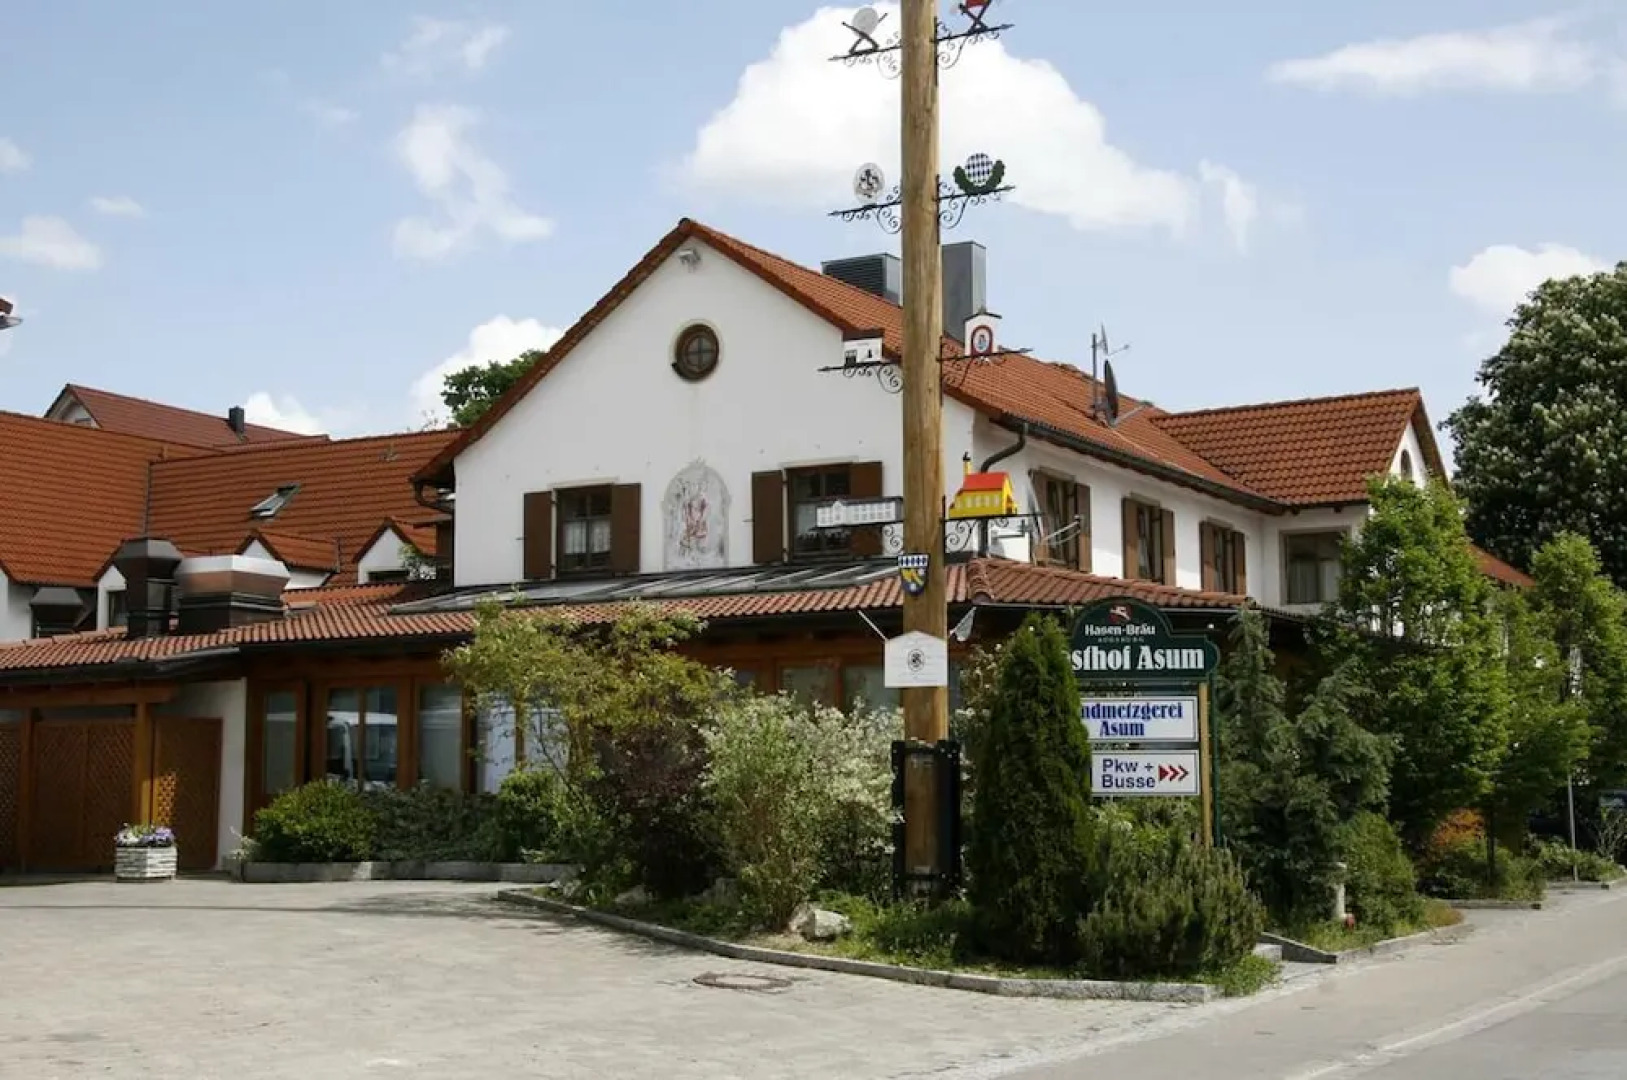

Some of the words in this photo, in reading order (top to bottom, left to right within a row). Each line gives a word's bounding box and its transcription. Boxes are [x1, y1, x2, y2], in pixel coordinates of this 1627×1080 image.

[1084, 623, 1155, 636] Hasen-Bräu
[1072, 645, 1131, 670] sthof
[1136, 645, 1205, 669] Asum
[1081, 702, 1183, 720] ndmetzgerei
[1100, 721, 1144, 736] Asum
[1102, 759, 1138, 772] Pkw
[1102, 774, 1156, 788] Busse
